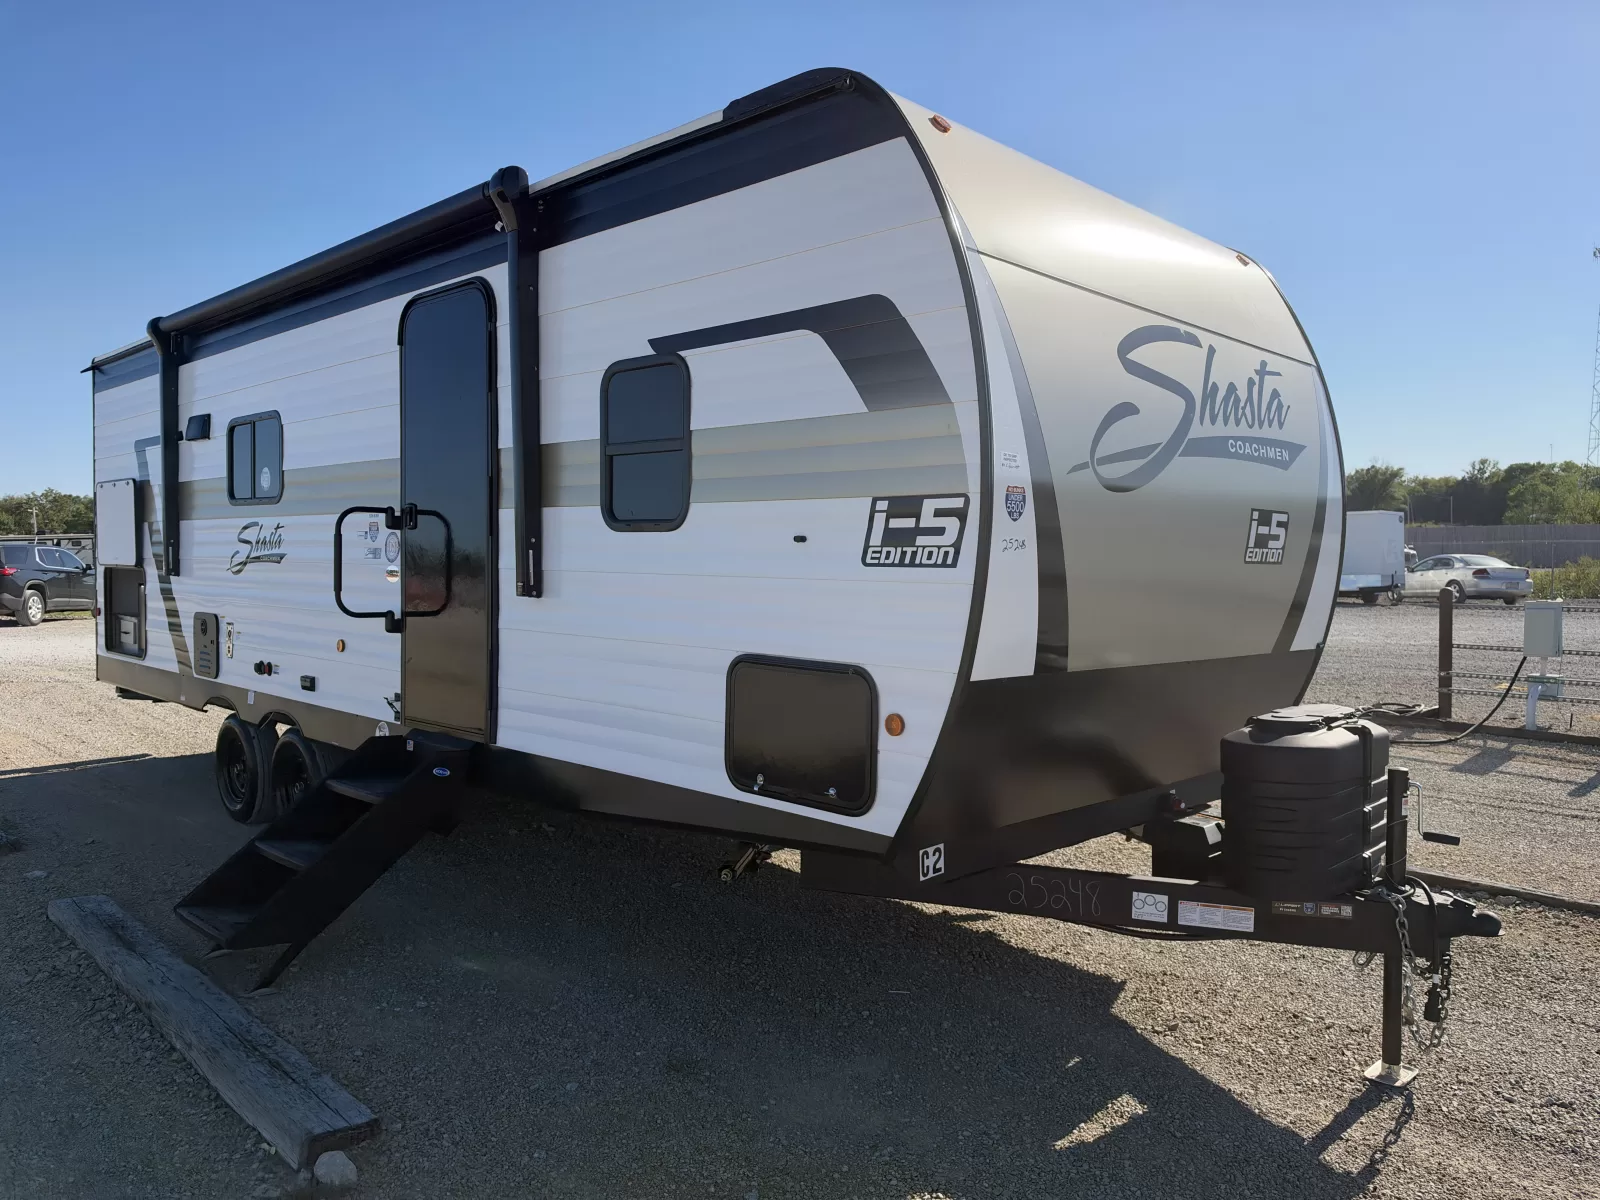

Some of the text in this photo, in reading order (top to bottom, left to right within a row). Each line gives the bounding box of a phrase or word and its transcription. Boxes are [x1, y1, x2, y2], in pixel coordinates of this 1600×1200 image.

[1090, 325, 1290, 493] Shasta
[1228, 439, 1289, 461] COACHMEN
[869, 497, 965, 546] i-5
[1006, 501, 1024, 512] 5500
[1248, 511, 1289, 549] i-5
[230, 521, 285, 575] Shasta
[865, 546, 955, 565] EDITION
[1245, 548, 1283, 563] EDITION
[920, 846, 943, 878] C2
[1006, 872, 1101, 917] 25248
